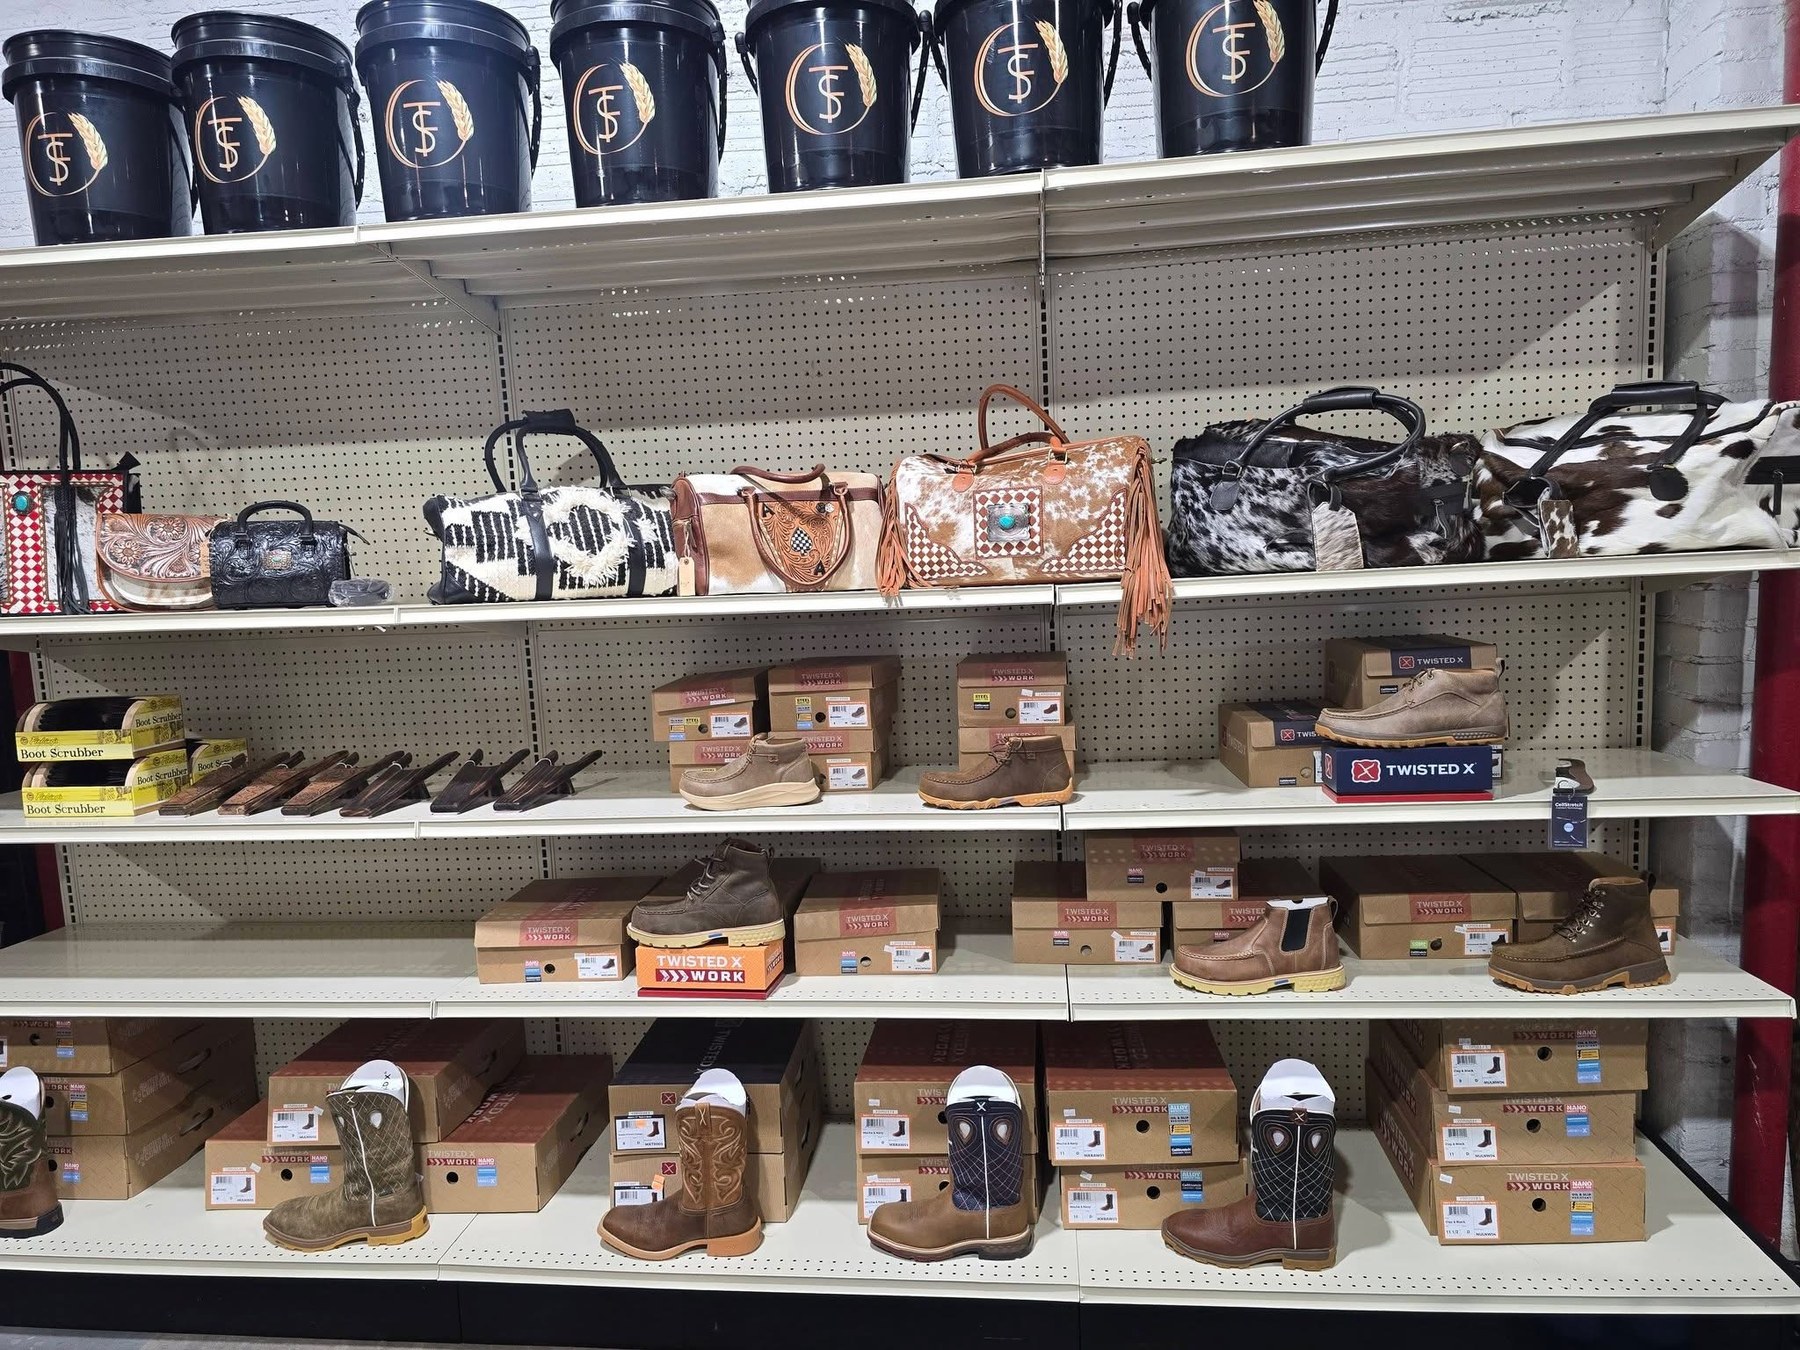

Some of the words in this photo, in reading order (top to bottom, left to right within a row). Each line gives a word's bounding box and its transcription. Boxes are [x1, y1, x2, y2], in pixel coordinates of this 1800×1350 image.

[1417, 657, 1456, 665] TWISTED
[1456, 656, 1464, 664] X
[135, 718, 151, 728] Boot
[152, 712, 182, 724] Scrubber
[21, 749, 47, 759] Boot
[50, 748, 104, 758] Scrubber
[197, 761, 214, 771] Boot
[1386, 763, 1460, 776] TWISTED
[1463, 763, 1476, 775] X
[137, 776, 153, 785] Boot
[155, 767, 188, 779] Scrubber
[27, 804, 52, 814] Boot
[55, 803, 106, 814] Scrubber
[846, 914, 881, 922] TWISTED
[527, 926, 563, 934] TWISTED
[656, 955, 728, 968] TWISTED
[731, 956, 743, 968] X
[690, 970, 745, 982] WORK
[699, 1030, 731, 1069] TWISTED
[1507, 1172, 1559, 1181] TWISTED
[1560, 1172, 1569, 1181] X
